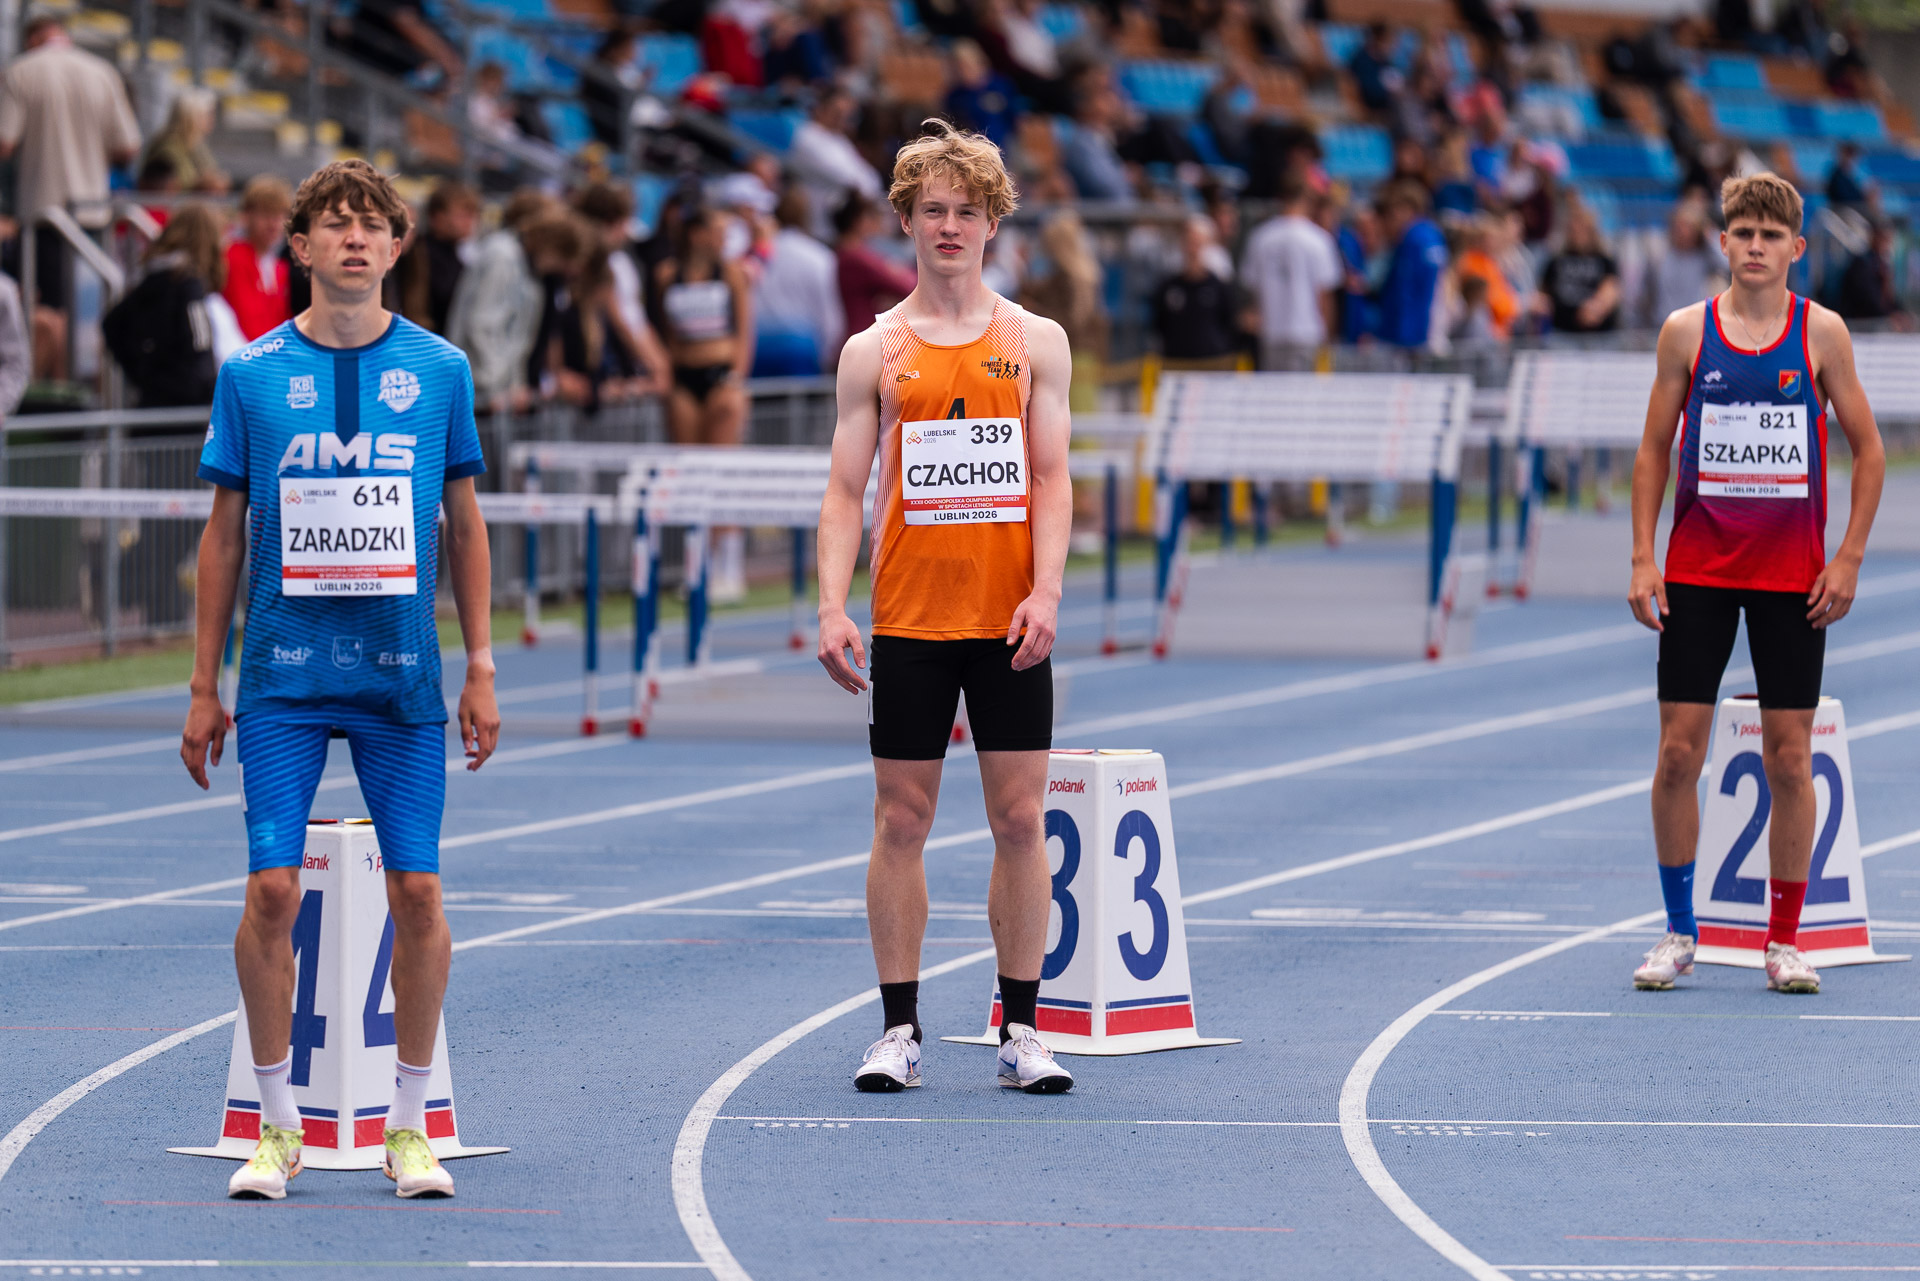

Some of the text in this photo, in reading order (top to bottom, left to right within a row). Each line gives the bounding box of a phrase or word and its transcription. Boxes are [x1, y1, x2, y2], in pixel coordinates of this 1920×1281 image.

[240, 337, 285, 361] deep
[896, 370, 920, 382] esa
[294, 380, 311, 393] KB
[377, 384, 422, 402] AMS
[1760, 411, 1797, 429] 821
[923, 429, 957, 437] LUBELSKIE
[970, 424, 1013, 444] 339
[277, 432, 417, 475] AMS
[1703, 443, 1802, 464] SZŁAPKA
[907, 461, 1020, 487] CZACHOR
[303, 489, 337, 498] LUBELSKIE
[353, 485, 400, 506] 614
[1724, 486, 1756, 494] LUBLIN
[934, 510, 998, 521] LUBLIN 2026
[289, 526, 405, 553] ZARADZKI
[314, 581, 383, 592] LUBLIN 2026
[1048, 777, 1086, 795] polanik
[1125, 776, 1158, 796] polanik
[1710, 751, 1772, 906] 2
[1804, 752, 1850, 906] 2
[303, 852, 330, 871] lanik
[1041, 809, 1081, 981] 3
[1114, 809, 1169, 981] 3
